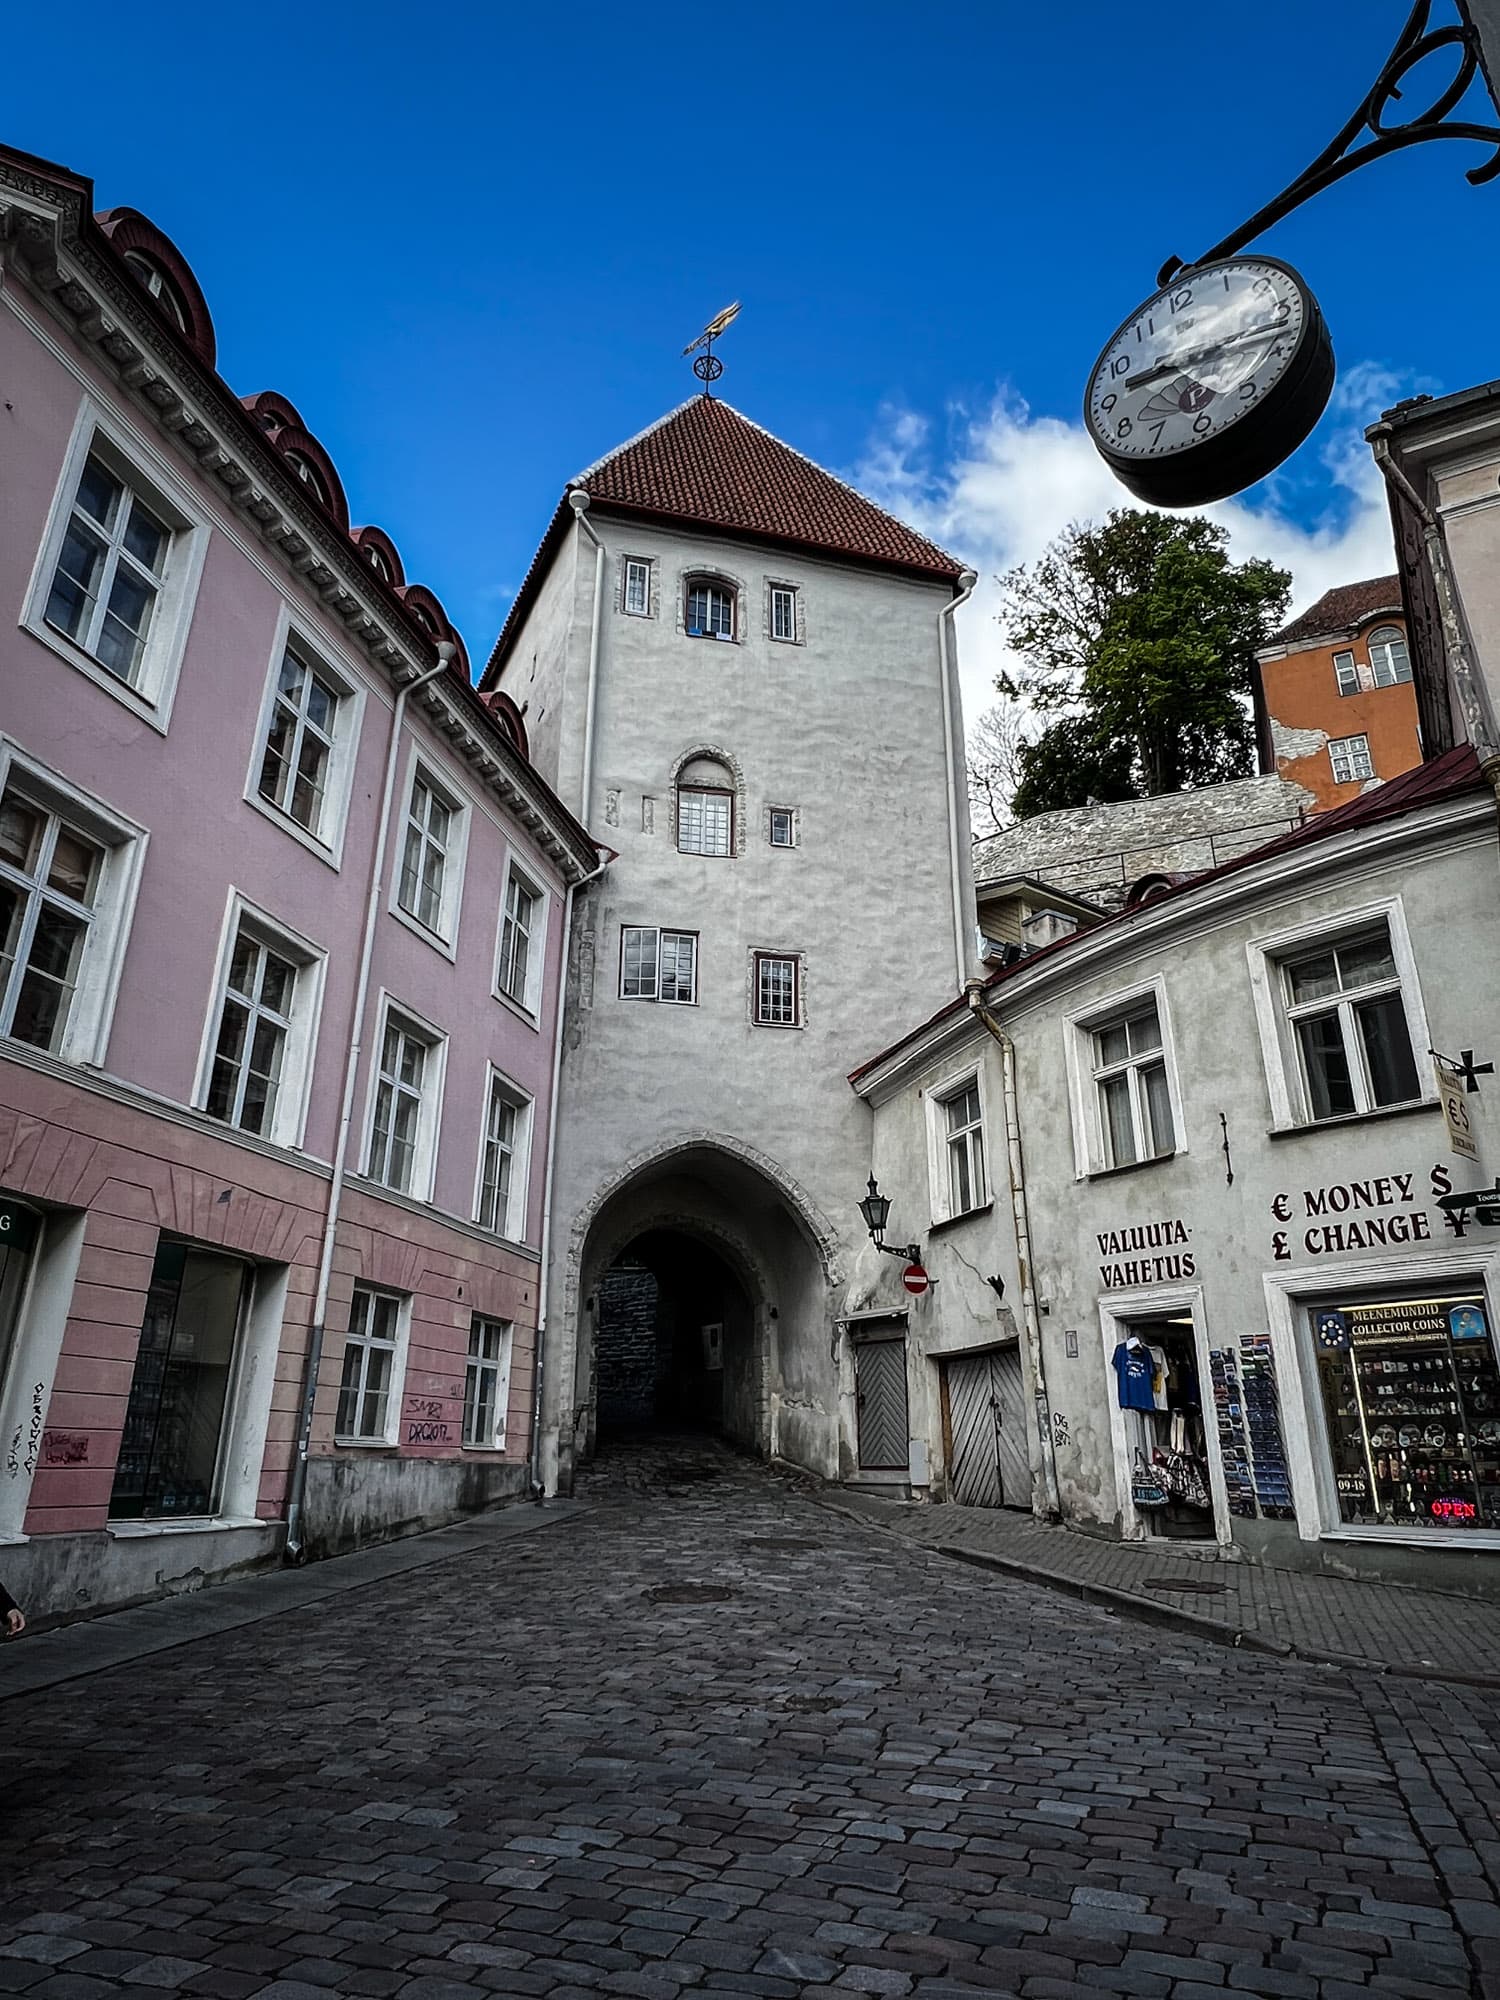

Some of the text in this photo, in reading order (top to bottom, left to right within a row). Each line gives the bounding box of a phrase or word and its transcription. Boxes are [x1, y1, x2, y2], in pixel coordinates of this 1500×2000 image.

[1169, 289, 1194, 314] 12
[1136, 318, 1154, 343] 11
[1110, 355, 1131, 380] 10
[1101, 393, 1117, 414] 9
[1117, 417, 1133, 438] 8
[1149, 420, 1166, 446] 7
[1193, 411, 1211, 433] 6
[1271, 1164, 1452, 1222] € MONEY $
[1097, 1219, 1192, 1256] VALUUTA-
[1271, 1208, 1471, 1260] £ CHANGE ¥
[1100, 1253, 1195, 1288] VAHETUS
[1352, 1304, 1439, 1322] MEENEMUNDID
[1351, 1318, 1446, 1336] COLLECTOR COINS
[1337, 1478, 1366, 1492] 09-18
[1431, 1500, 1476, 1517] OPEN
